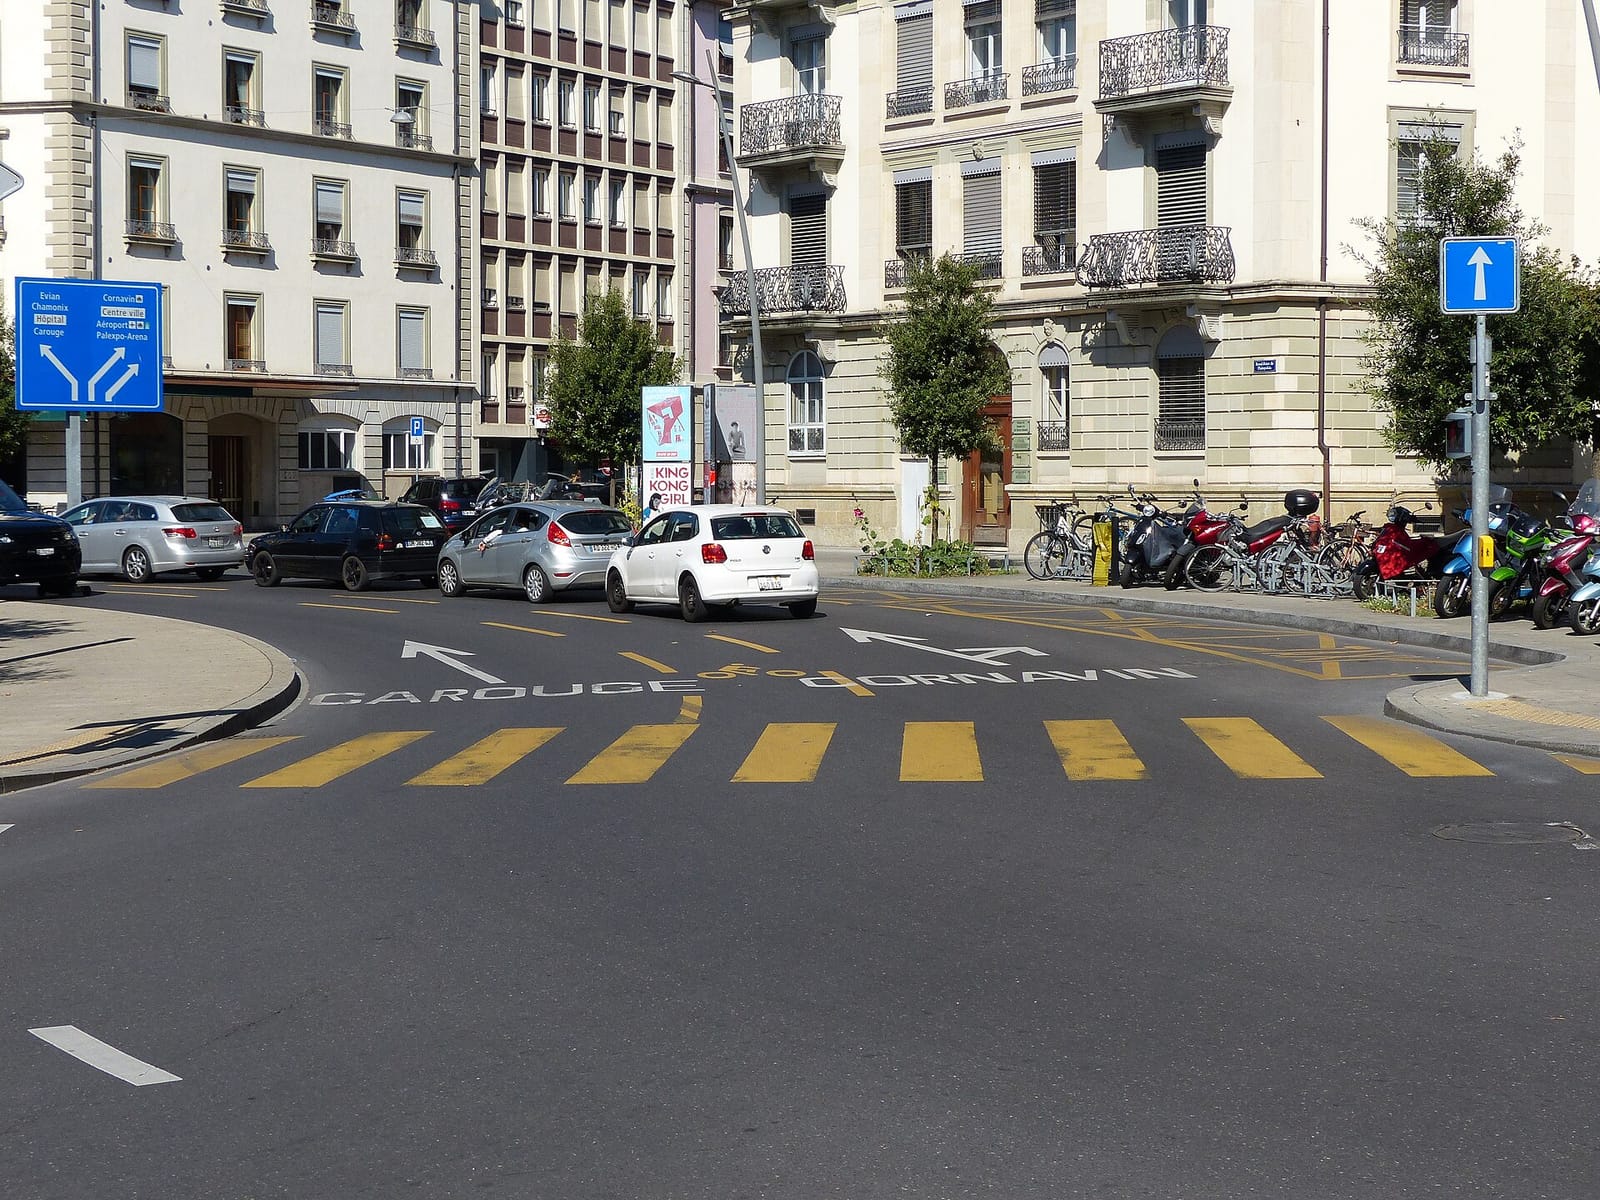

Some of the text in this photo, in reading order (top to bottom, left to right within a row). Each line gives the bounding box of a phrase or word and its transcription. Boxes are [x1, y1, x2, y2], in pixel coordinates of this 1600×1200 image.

[40, 291, 60, 300] Evian
[103, 293, 136, 303] Cornavin
[32, 302, 69, 311] Chamonix
[102, 307, 145, 318] Centre ville
[36, 314, 64, 324] Hôpital
[96, 319, 128, 330] Aéroport
[33, 327, 64, 338] Carouge
[96, 331, 148, 341] Palexpo-Arena
[414, 420, 421, 435] P
[655, 466, 689, 479] KING
[649, 480, 689, 492] KONG
[660, 493, 689, 504] GIRL
[800, 667, 1199, 689] CORNAVIN
[308, 679, 706, 706] CAROUGE
